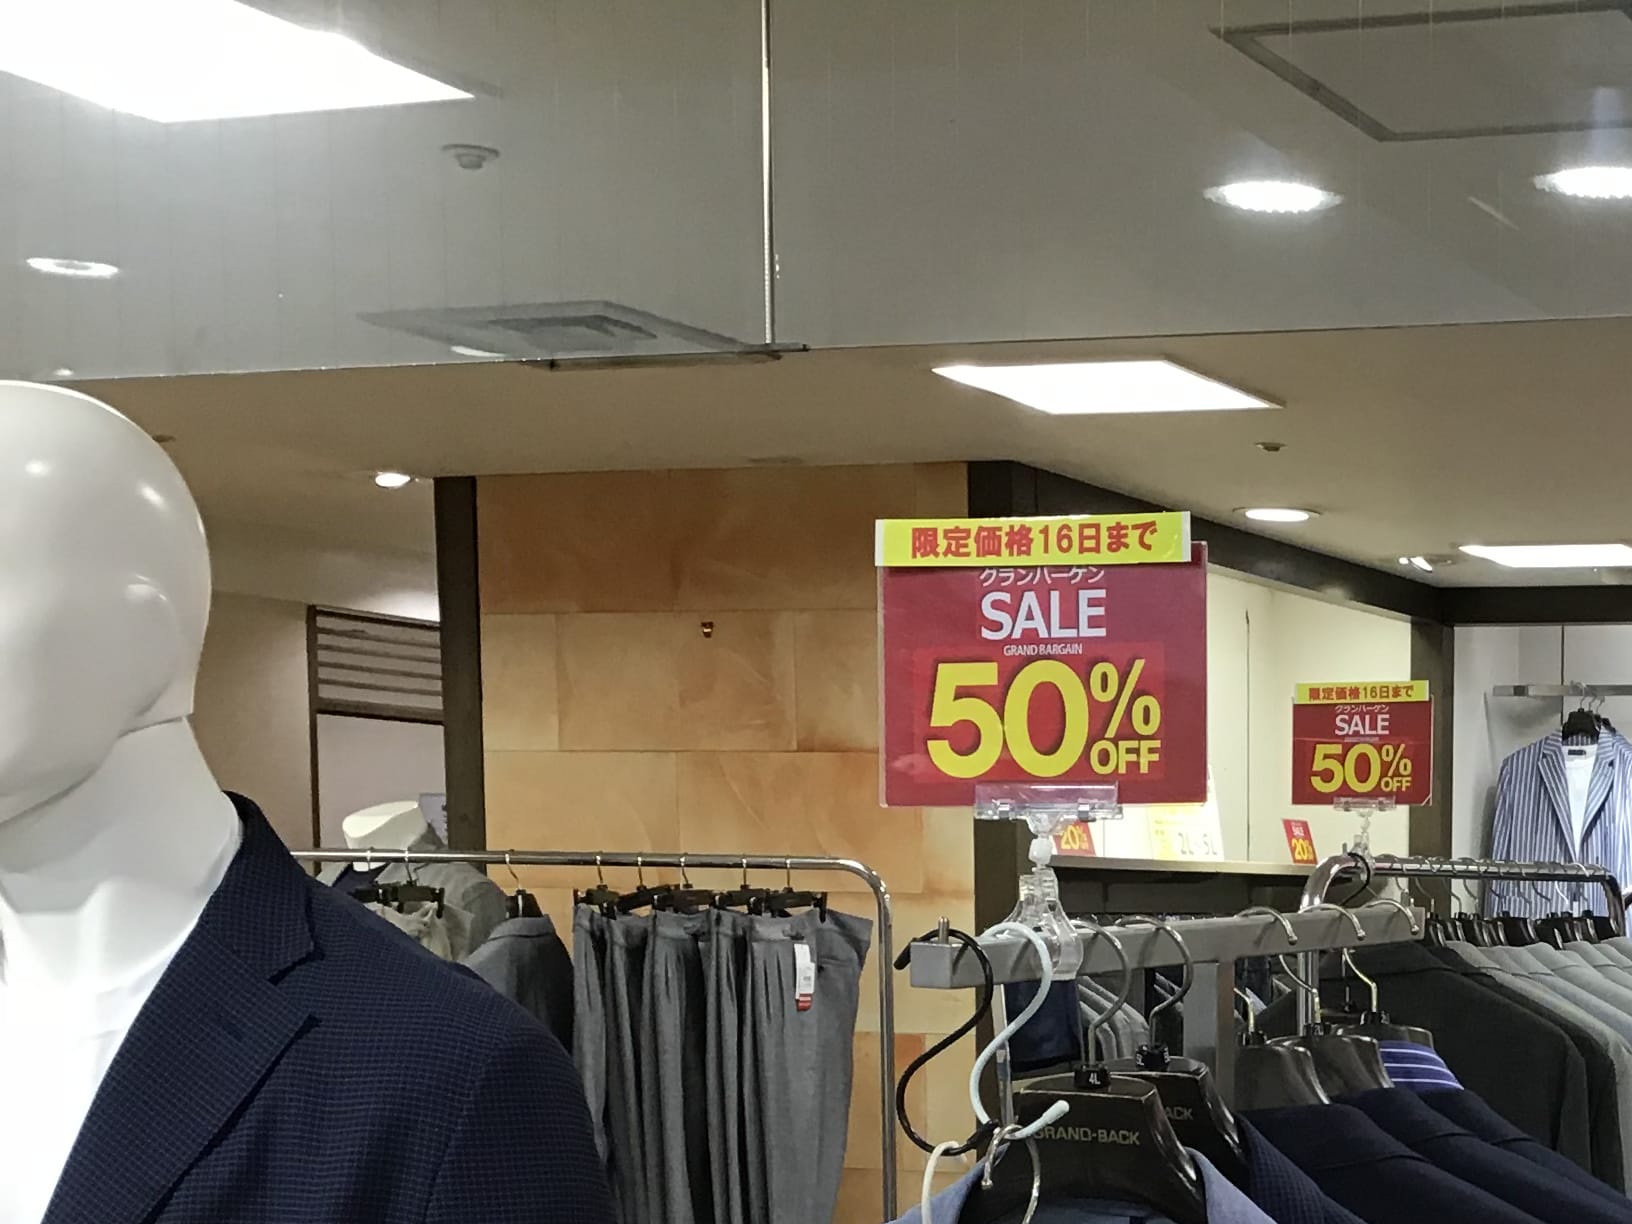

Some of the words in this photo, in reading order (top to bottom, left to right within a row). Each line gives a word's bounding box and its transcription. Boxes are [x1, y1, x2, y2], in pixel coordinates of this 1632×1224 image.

[911, 520, 1158, 559] 限定価格16日まで
[980, 589, 1107, 640] SALE
[1003, 643, 1038, 656] GRAND
[1039, 643, 1083, 655] BARGAIN
[1308, 684, 1415, 701] 限定価格16日まで
[926, 658, 1161, 779] 50%
[1334, 714, 1390, 735] SALE
[1089, 740, 1161, 775] OFF
[1310, 743, 1412, 793] 50%
[1380, 777, 1412, 792] OFF
[1088, 1072, 1101, 1085] 4L
